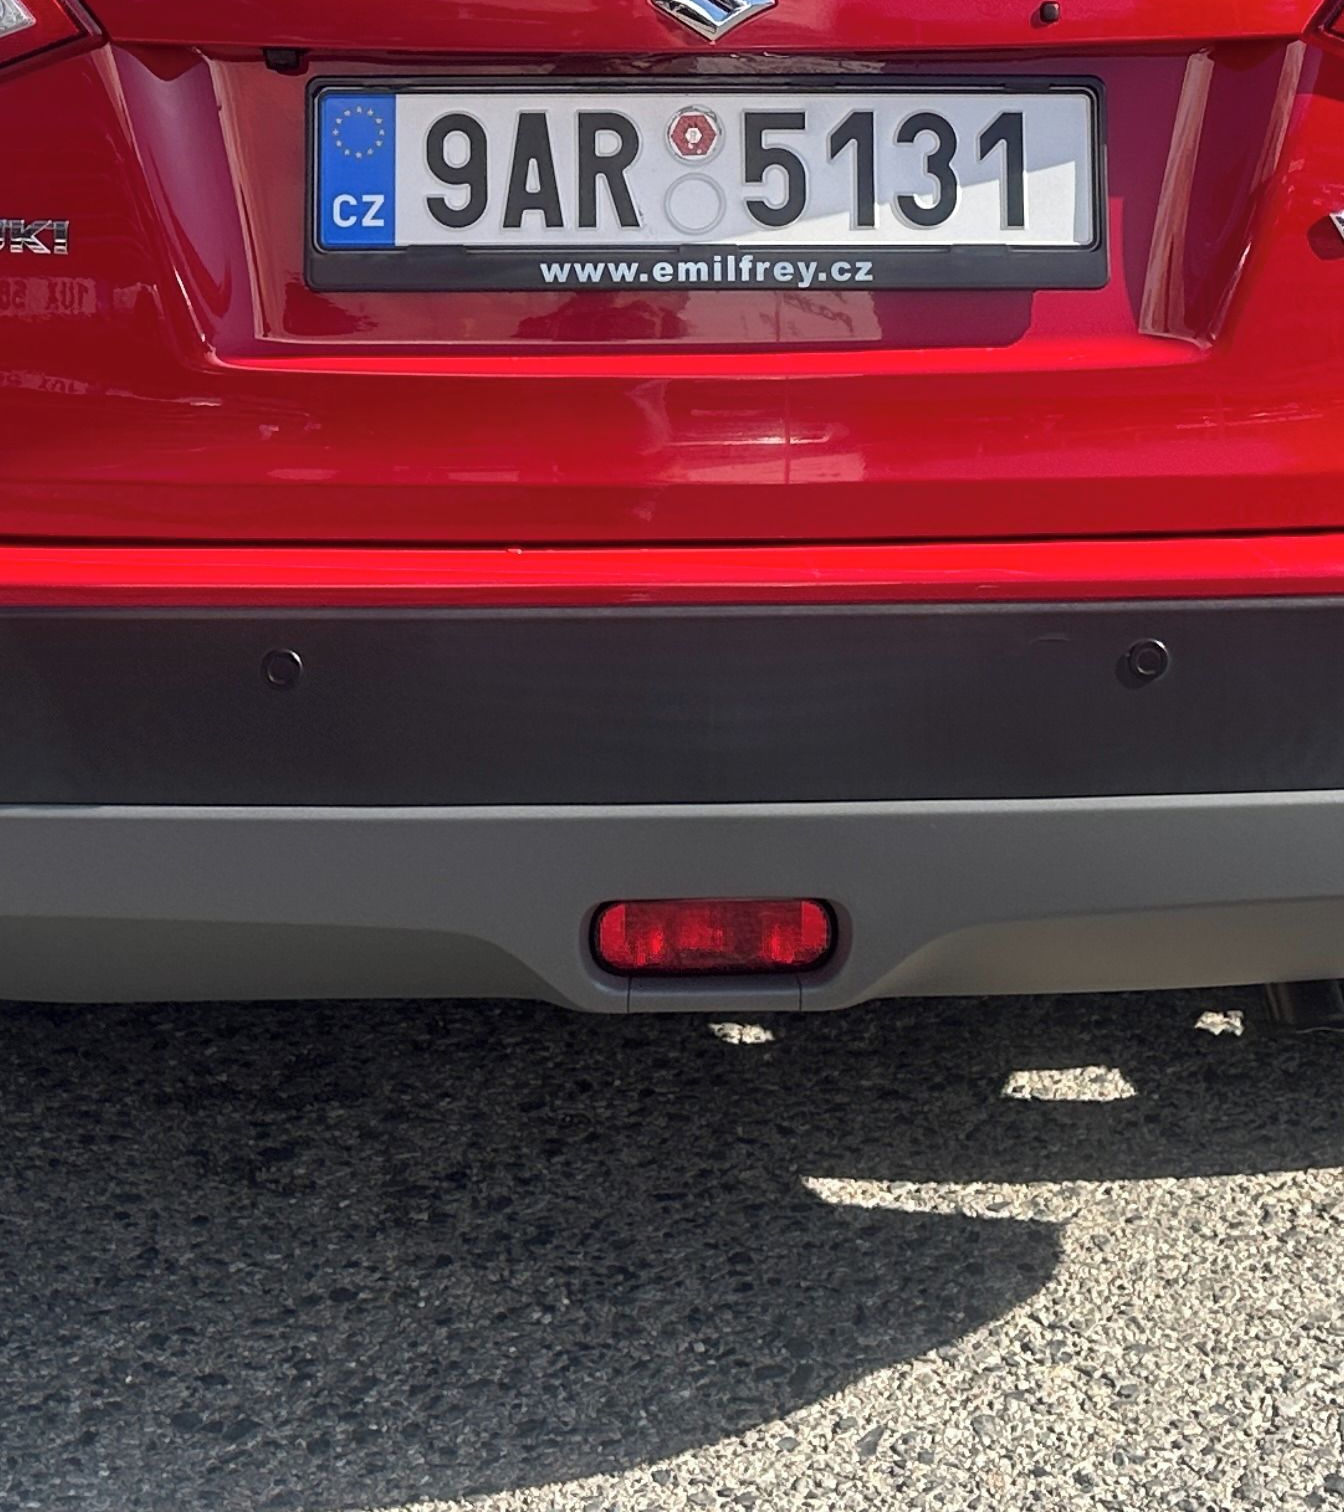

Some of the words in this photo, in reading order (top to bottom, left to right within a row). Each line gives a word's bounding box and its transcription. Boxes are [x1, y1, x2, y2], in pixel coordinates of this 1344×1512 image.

[425, 111, 641, 229] 9AR
[743, 111, 1026, 229] 5131
[331, 194, 386, 228] CZ
[540, 255, 874, 288] www.emilfrey.cz
